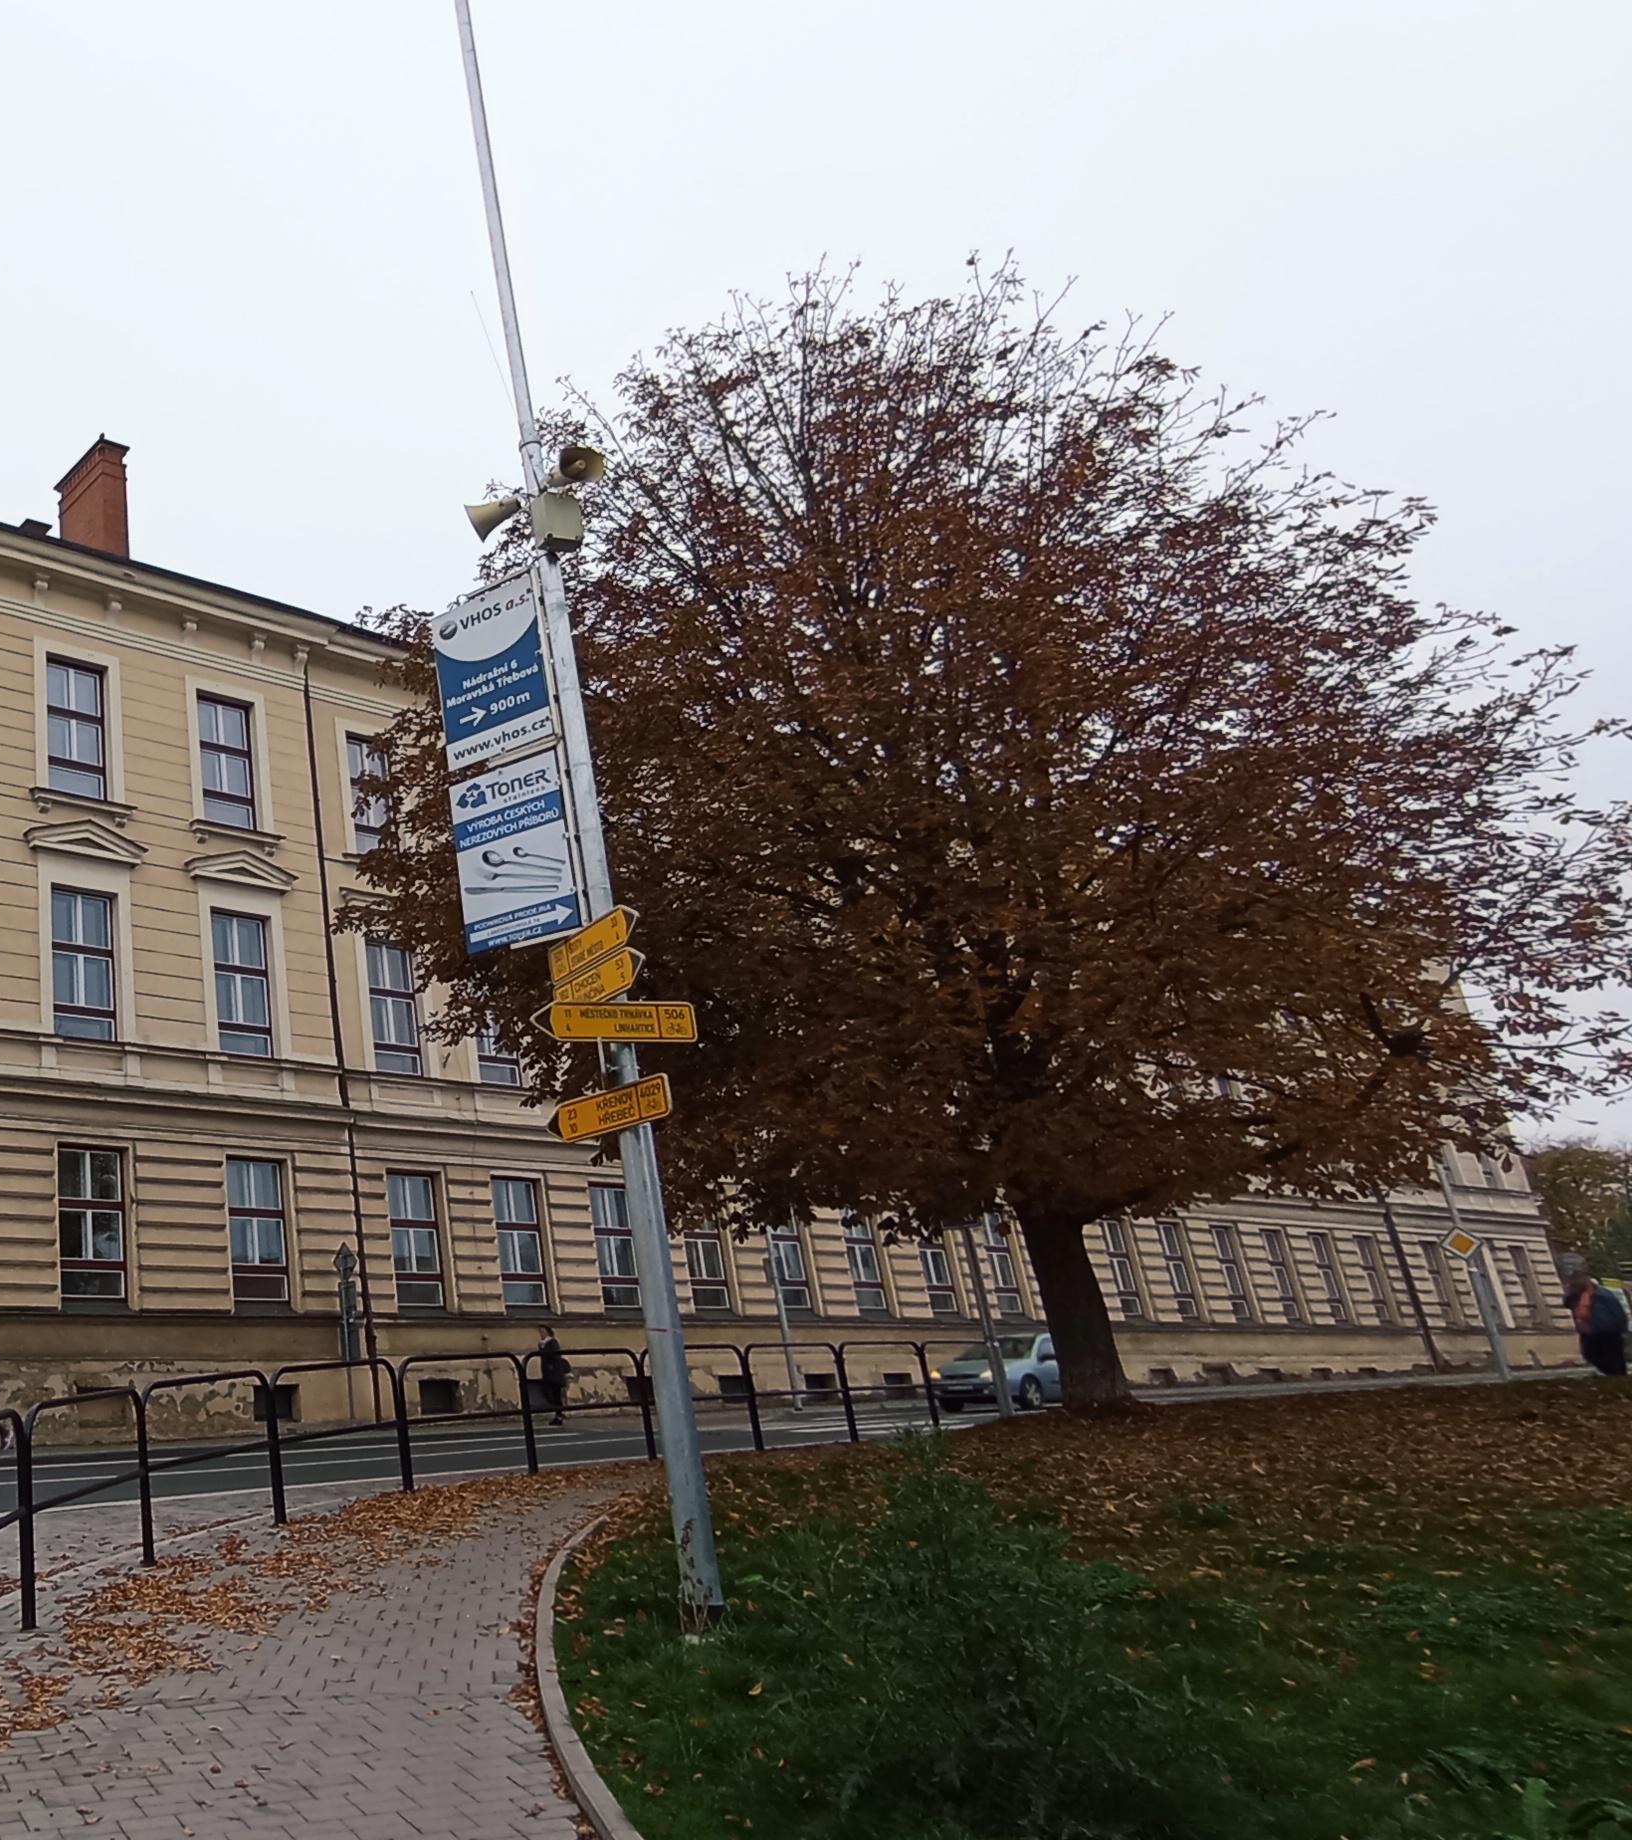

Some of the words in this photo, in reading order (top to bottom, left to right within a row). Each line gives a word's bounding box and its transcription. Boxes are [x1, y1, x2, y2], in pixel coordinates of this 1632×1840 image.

[460, 602, 502, 630] VHOS
[505, 594, 529, 611] a.s.
[446, 681, 495, 708] Moravská
[496, 662, 539, 688] Třebová
[462, 662, 508, 689] Nádražní
[510, 659, 518, 669] 6
[453, 720, 546, 760] www.vhos.cz
[459, 822, 517, 848] NEREZOVÝCH
[518, 806, 559, 829] PŘÍBORŮ
[466, 813, 503, 833] VÝROBA
[504, 799, 545, 819] ČESKÝCH
[664, 1009, 685, 1020] 506
[598, 1104, 635, 1125] HŘEBEČ
